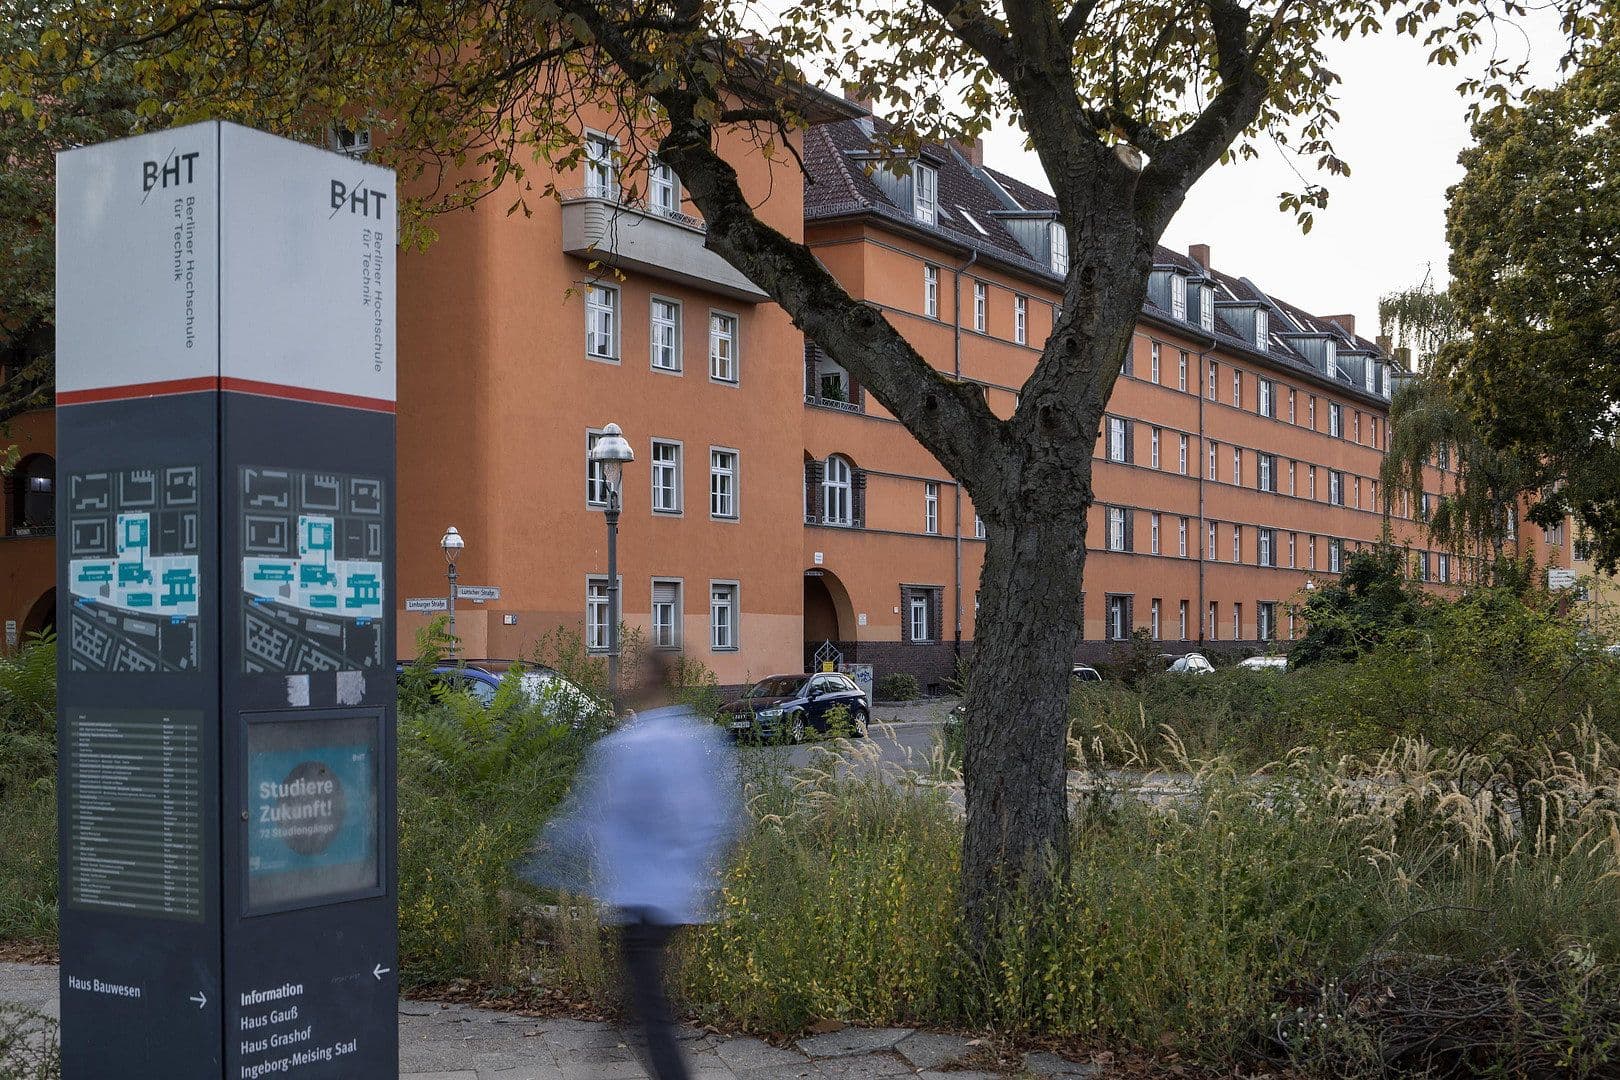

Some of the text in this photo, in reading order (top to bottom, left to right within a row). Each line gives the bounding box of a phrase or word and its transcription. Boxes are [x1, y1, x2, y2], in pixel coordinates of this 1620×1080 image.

[173, 197, 183, 282] für Technik
[184, 196, 195, 350] Berliner Hochschule
[362, 228, 371, 306] für Technik
[373, 231, 384, 373] Berliner Hochschule
[260, 778, 333, 799] Studiere
[260, 801, 332, 823] Zukunft!
[273, 823, 334, 837] Studiengänge
[68, 975, 141, 997] Haus Bauwesen
[240, 983, 304, 1006] Information
[240, 1005, 299, 1031] Haus Gauß
[240, 1025, 312, 1055] Haus Grashof
[240, 1038, 358, 1079] Ingeborg-Meising Saal
